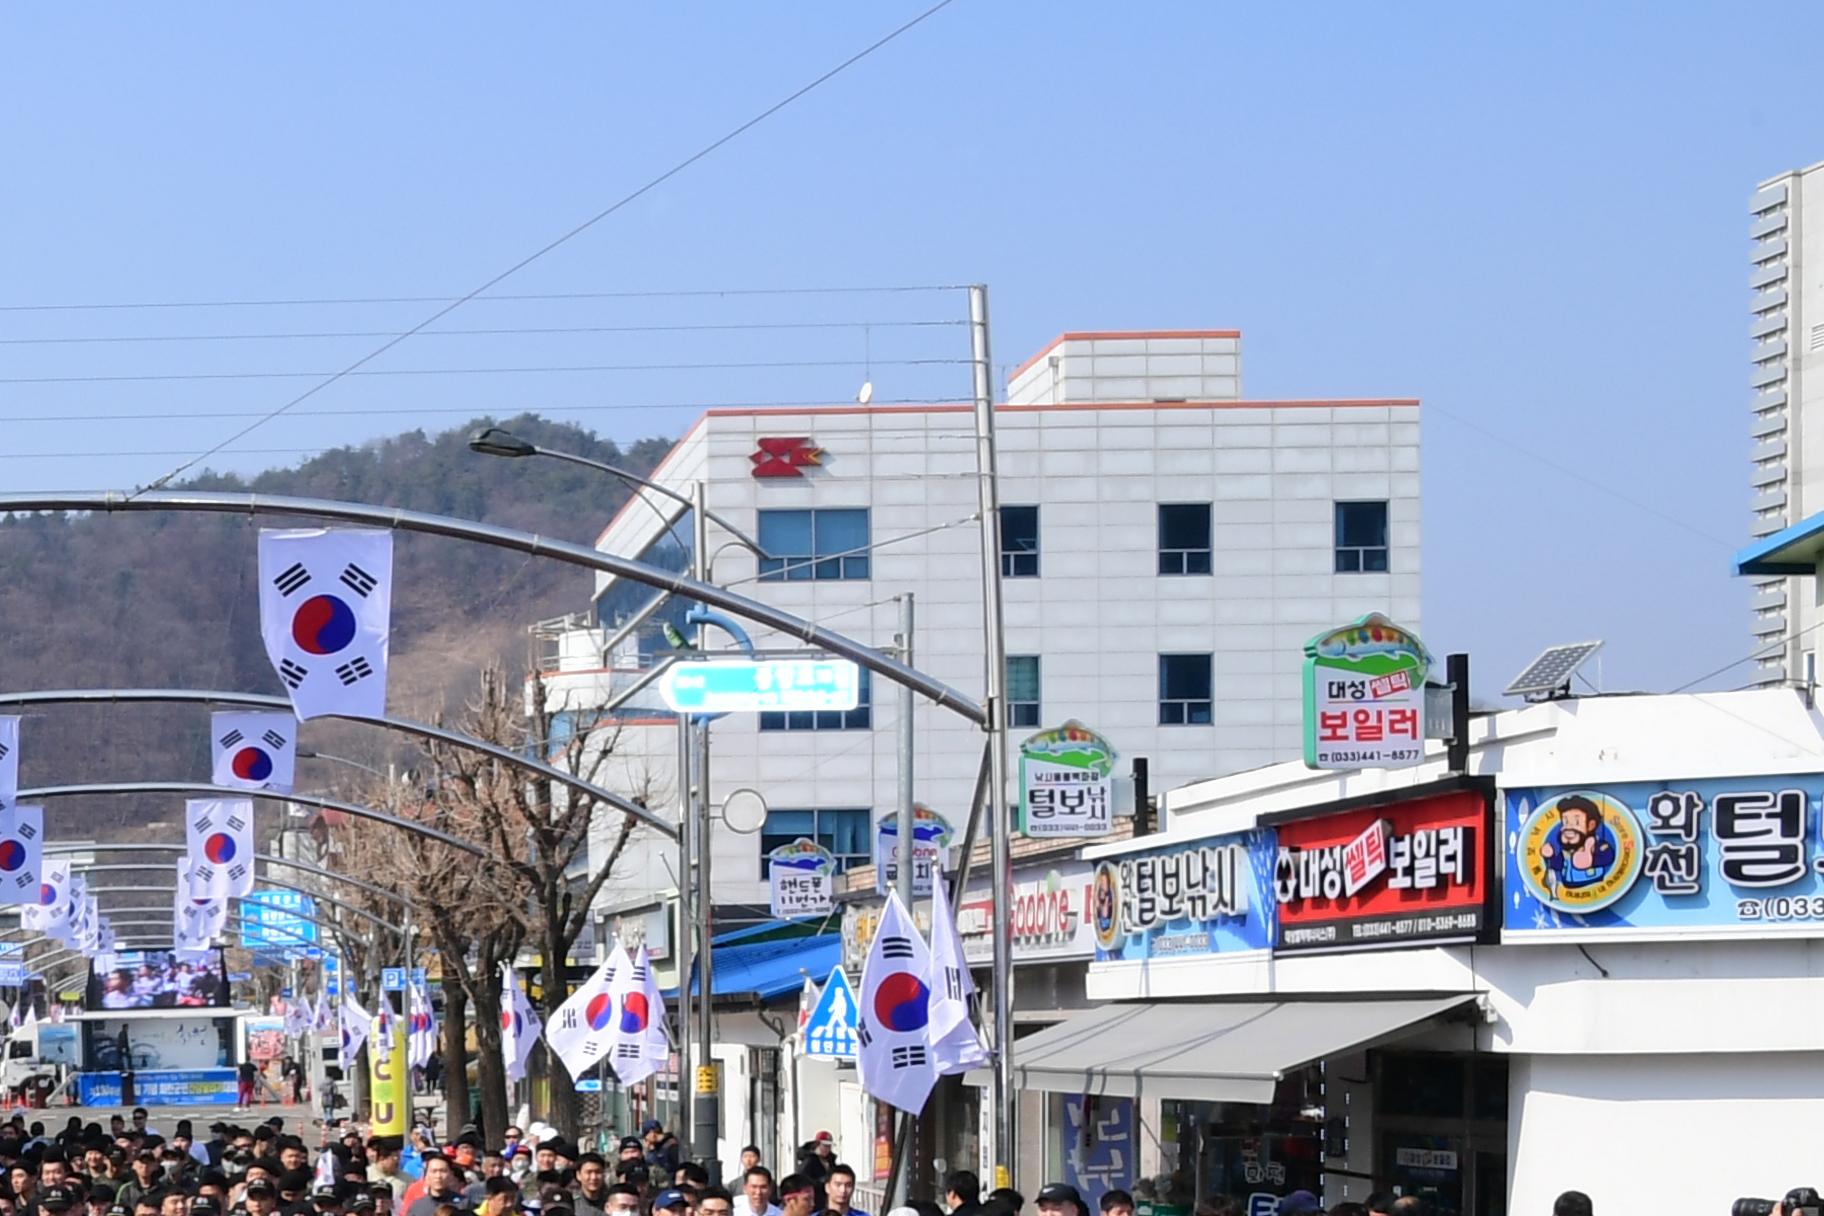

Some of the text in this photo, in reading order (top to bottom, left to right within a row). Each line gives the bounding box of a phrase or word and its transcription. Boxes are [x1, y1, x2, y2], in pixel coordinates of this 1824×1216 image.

[1328, 681, 1366, 700] 대성
[1320, 709, 1417, 741] 보일러
[1136, 846, 1237, 926] 털보낚시
[1300, 846, 1341, 899] 대성
[1388, 827, 1464, 889] 보일러
